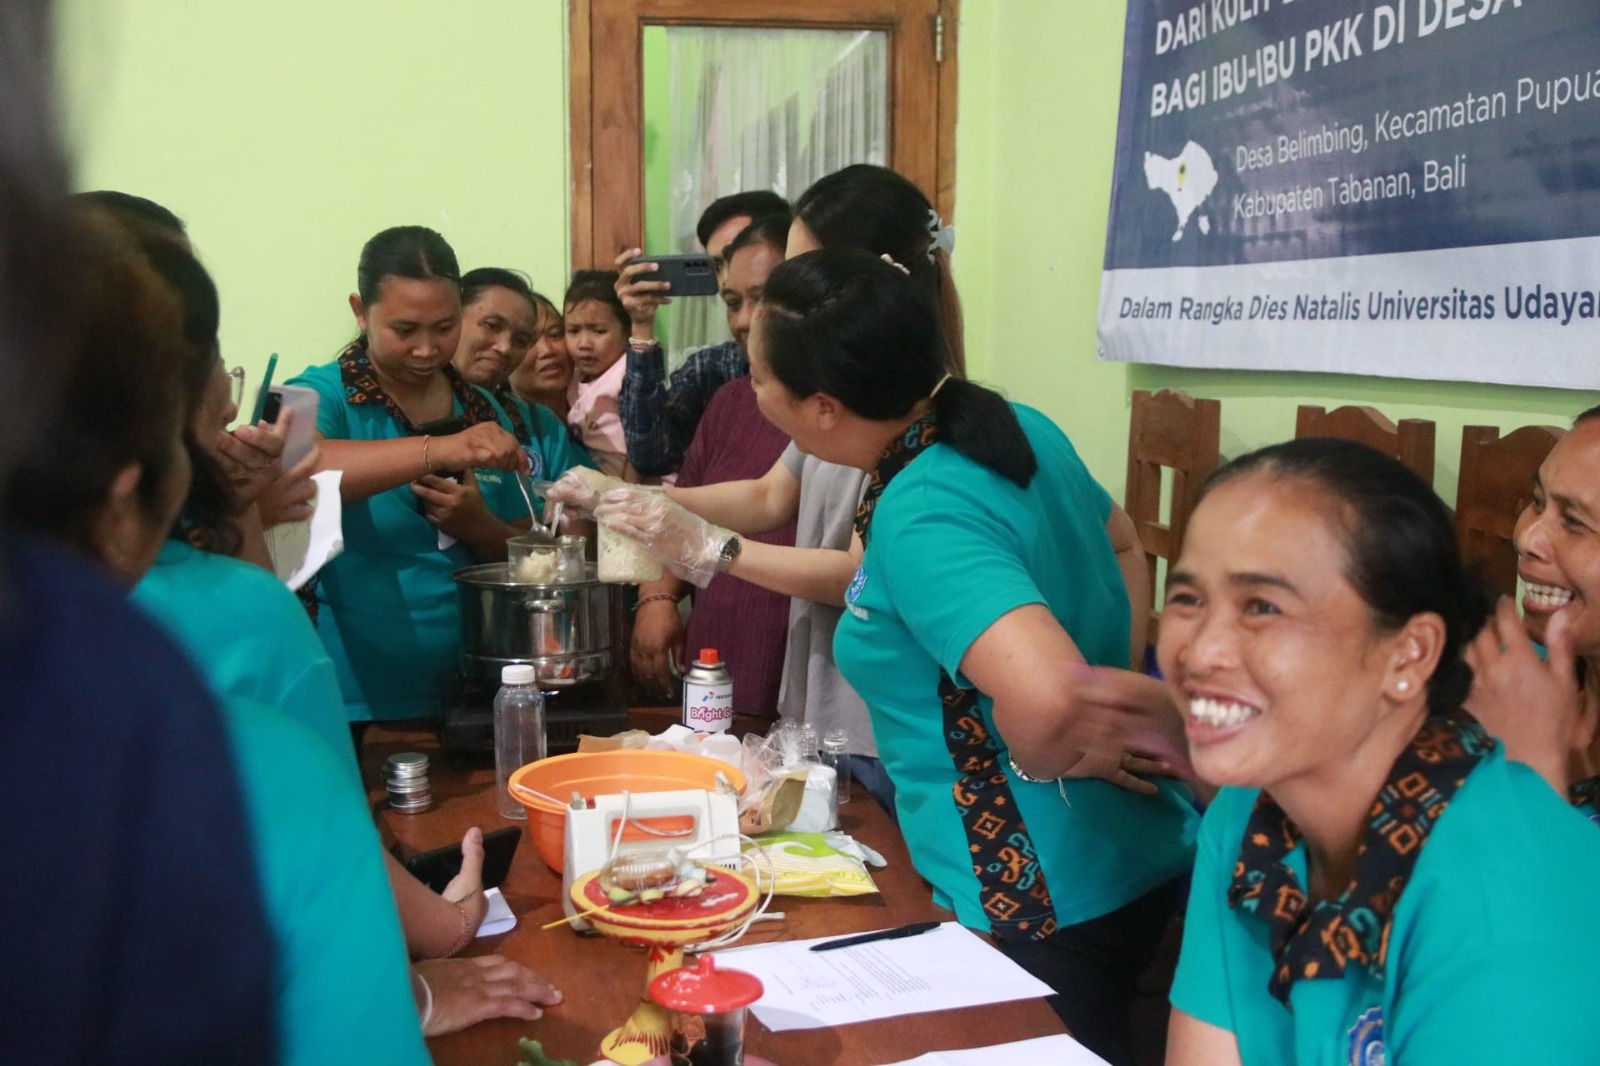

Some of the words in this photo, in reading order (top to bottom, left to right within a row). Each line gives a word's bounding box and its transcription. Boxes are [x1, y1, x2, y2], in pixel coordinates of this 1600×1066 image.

[1155, 2, 1207, 55] DARI
[1151, 70, 1206, 117] BAGI
[1213, 37, 1296, 101] IBU-IBU
[1305, 13, 1364, 72] PKK
[1373, 0, 1405, 51] DI
[1418, 0, 1522, 38] DE
[1236, 146, 1273, 172] Desa
[1277, 122, 1369, 164] Belimbing,
[1375, 91, 1506, 143] Kecamatan
[1234, 184, 1324, 219] Kabupaten
[1328, 172, 1416, 205] Tabanan,
[1423, 154, 1467, 193] Bali
[1120, 295, 1172, 319] Dalam
[1179, 295, 1243, 325] Rangka
[1249, 294, 1288, 320] Dies
[1293, 291, 1360, 320] Natalis
[1368, 287, 1495, 320] Universitas
[1505, 284, 1600, 326] Udaya
[691, 706, 723, 722] Bright
